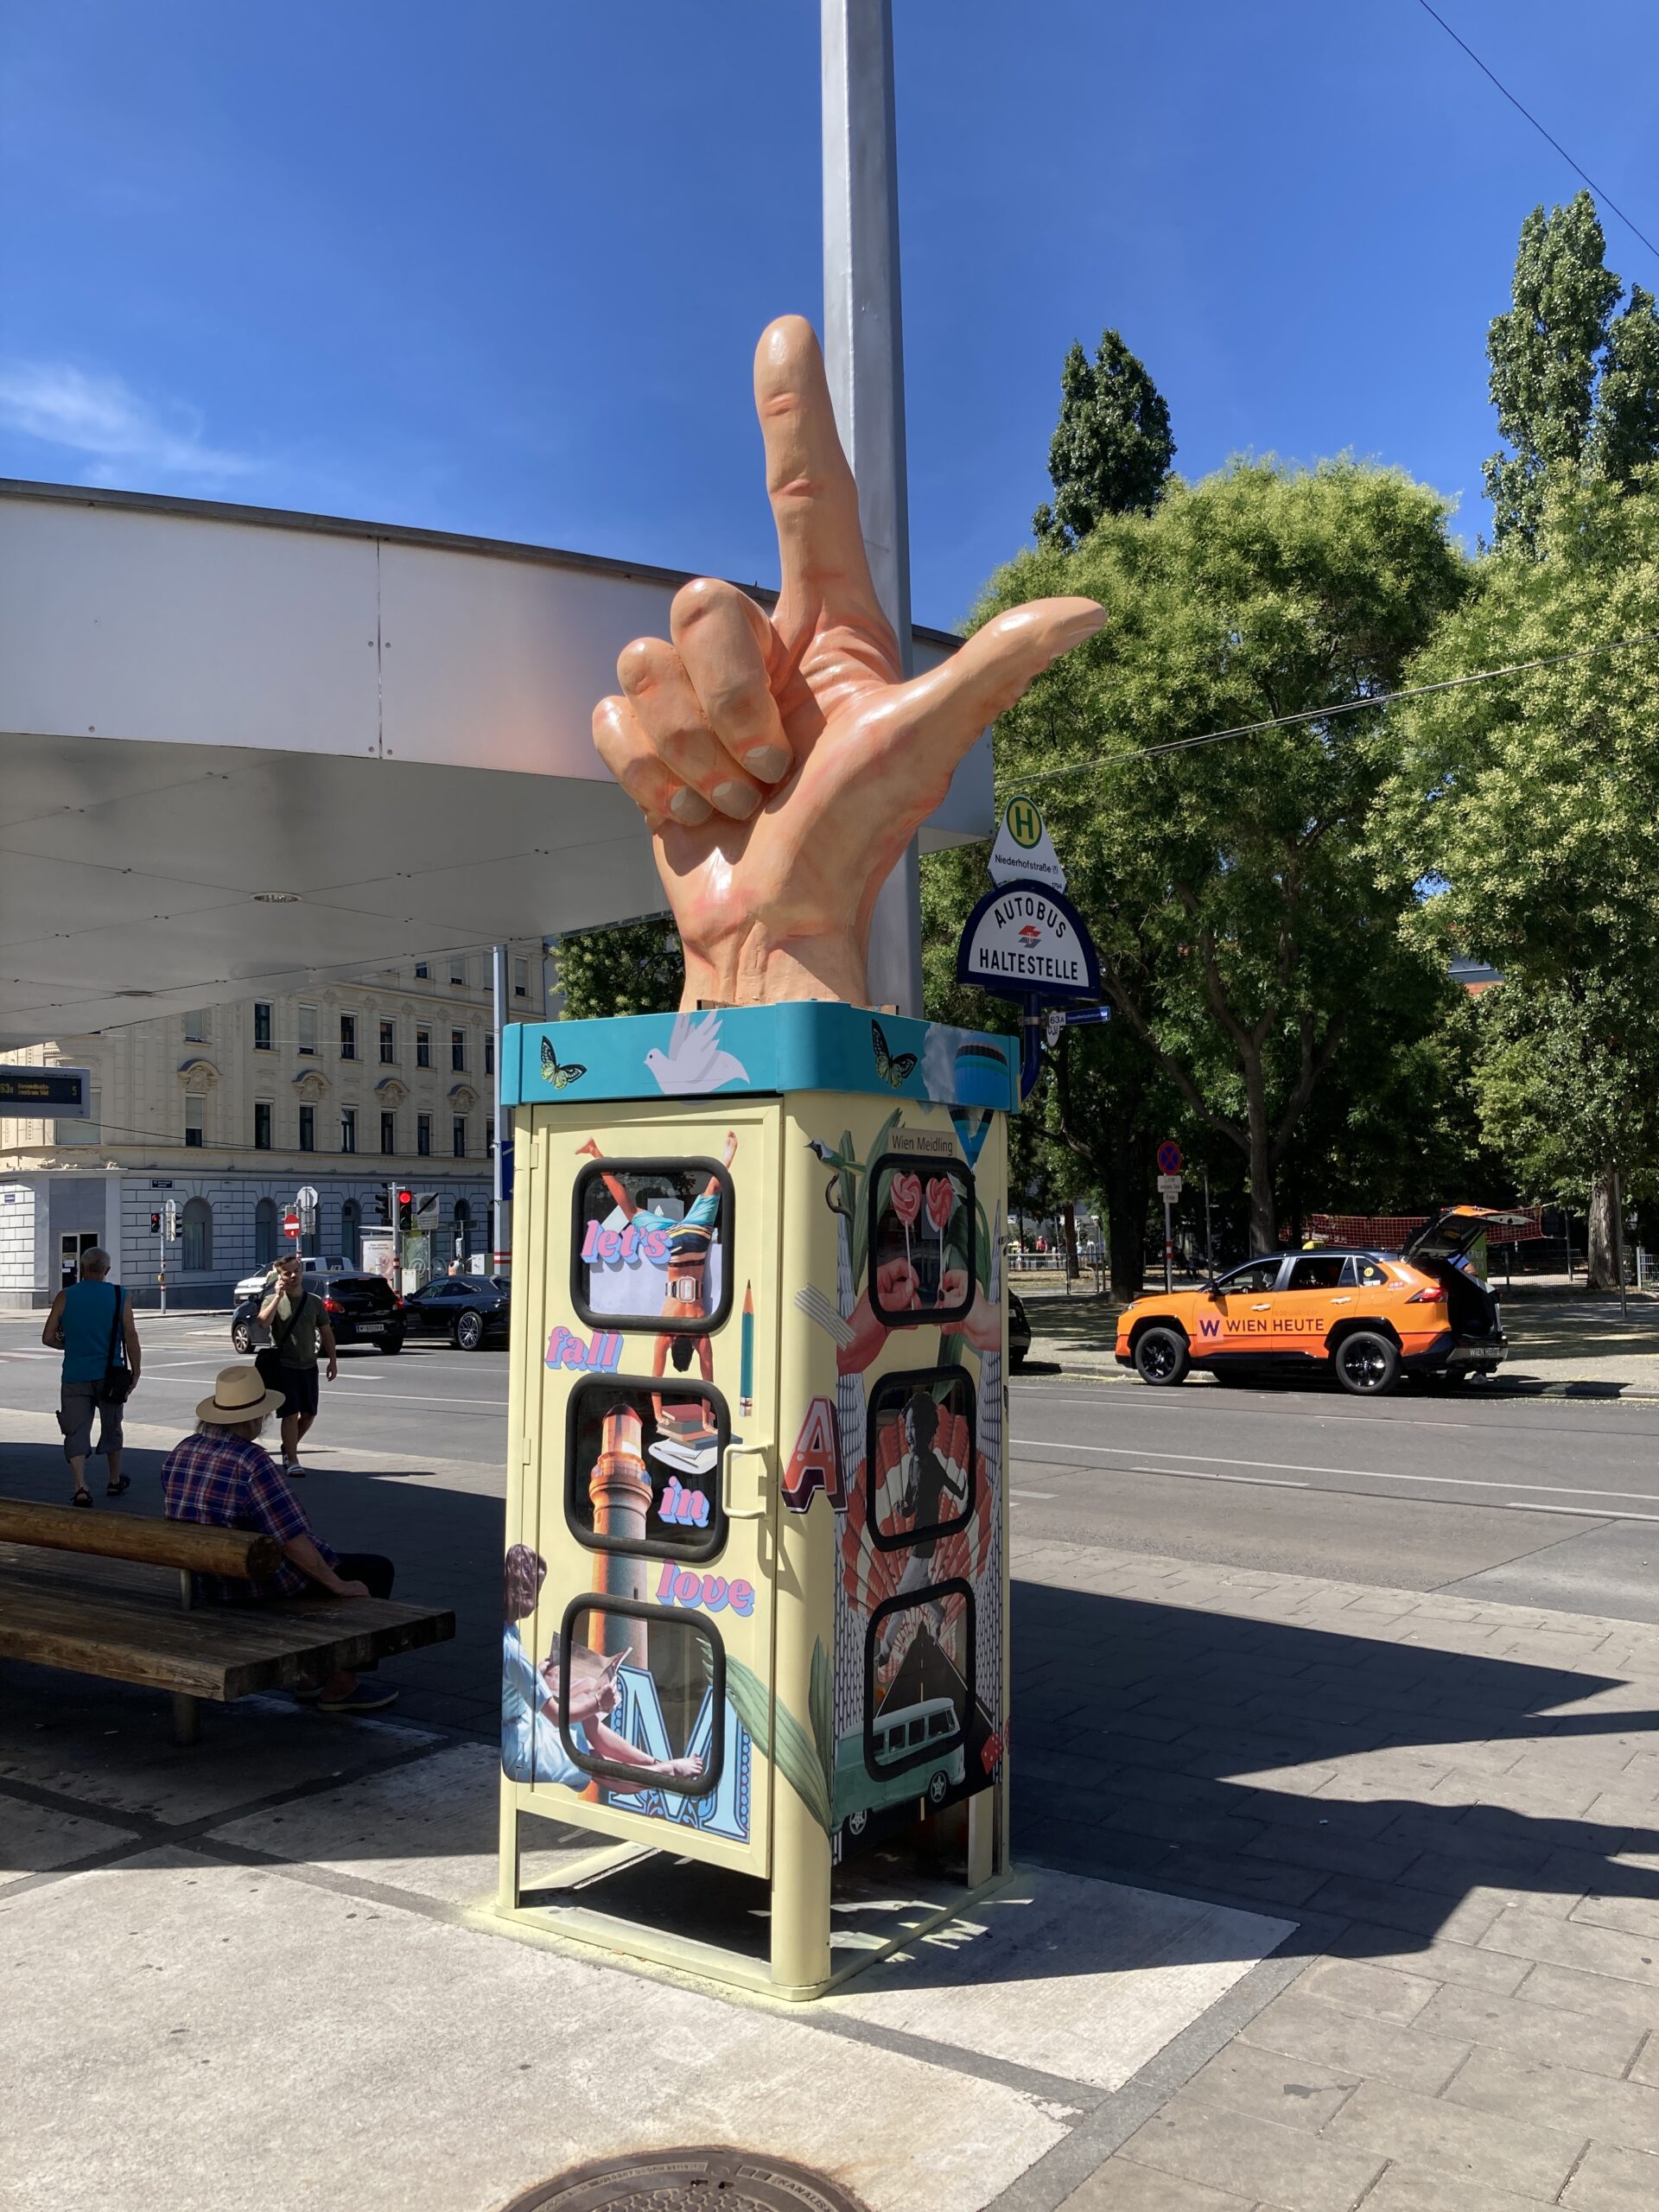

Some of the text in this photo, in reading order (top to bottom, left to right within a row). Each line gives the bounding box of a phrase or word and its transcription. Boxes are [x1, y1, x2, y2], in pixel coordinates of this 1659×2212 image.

[1014, 805, 1034, 840] H
[995, 854, 1052, 874] Niederhofstraße
[994, 897, 1066, 938] AUTOBUS
[979, 947, 1078, 981] HALTESTELLE
[1050, 1015, 1065, 1025] 63A
[892, 1135, 953, 1156] Wien Meidling
[581, 1219, 673, 1264] let's
[1198, 1319, 1325, 1337] W WIEN HEUTE
[545, 1325, 624, 1374] fall
[1485, 1347, 1501, 1356] HEUTE
[658, 1476, 710, 1528] in
[656, 1559, 755, 1618] love
